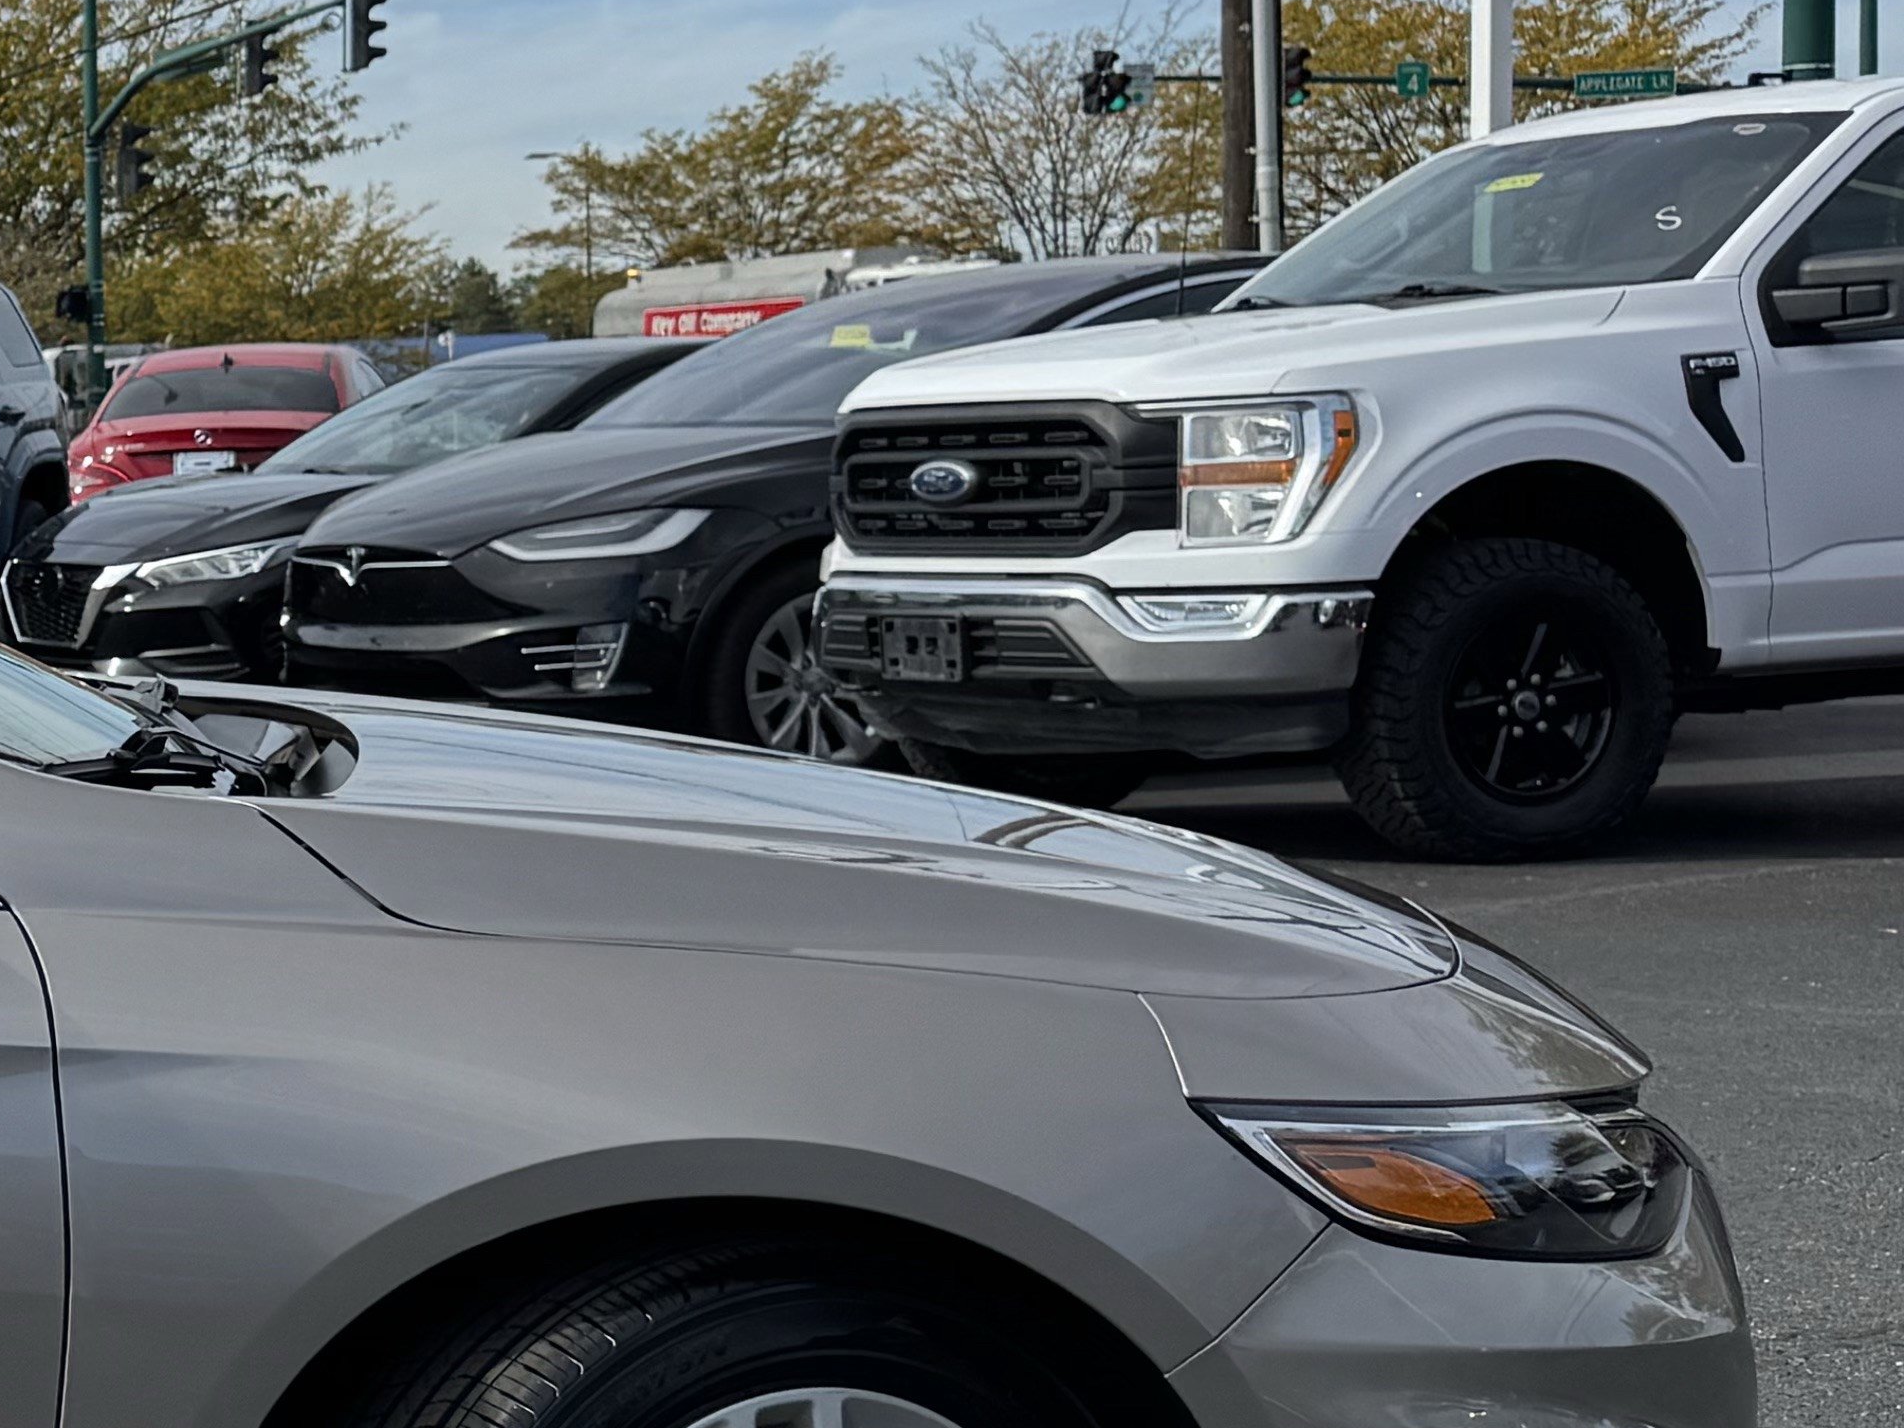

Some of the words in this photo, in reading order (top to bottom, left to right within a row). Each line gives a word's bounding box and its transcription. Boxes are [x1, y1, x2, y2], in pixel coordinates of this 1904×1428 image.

[1579, 75, 1644, 92] APPLEGATE
[1652, 74, 1668, 89] LN
[1655, 205, 1682, 231] S
[652, 315, 676, 337] Key
[700, 310, 762, 333] Company
